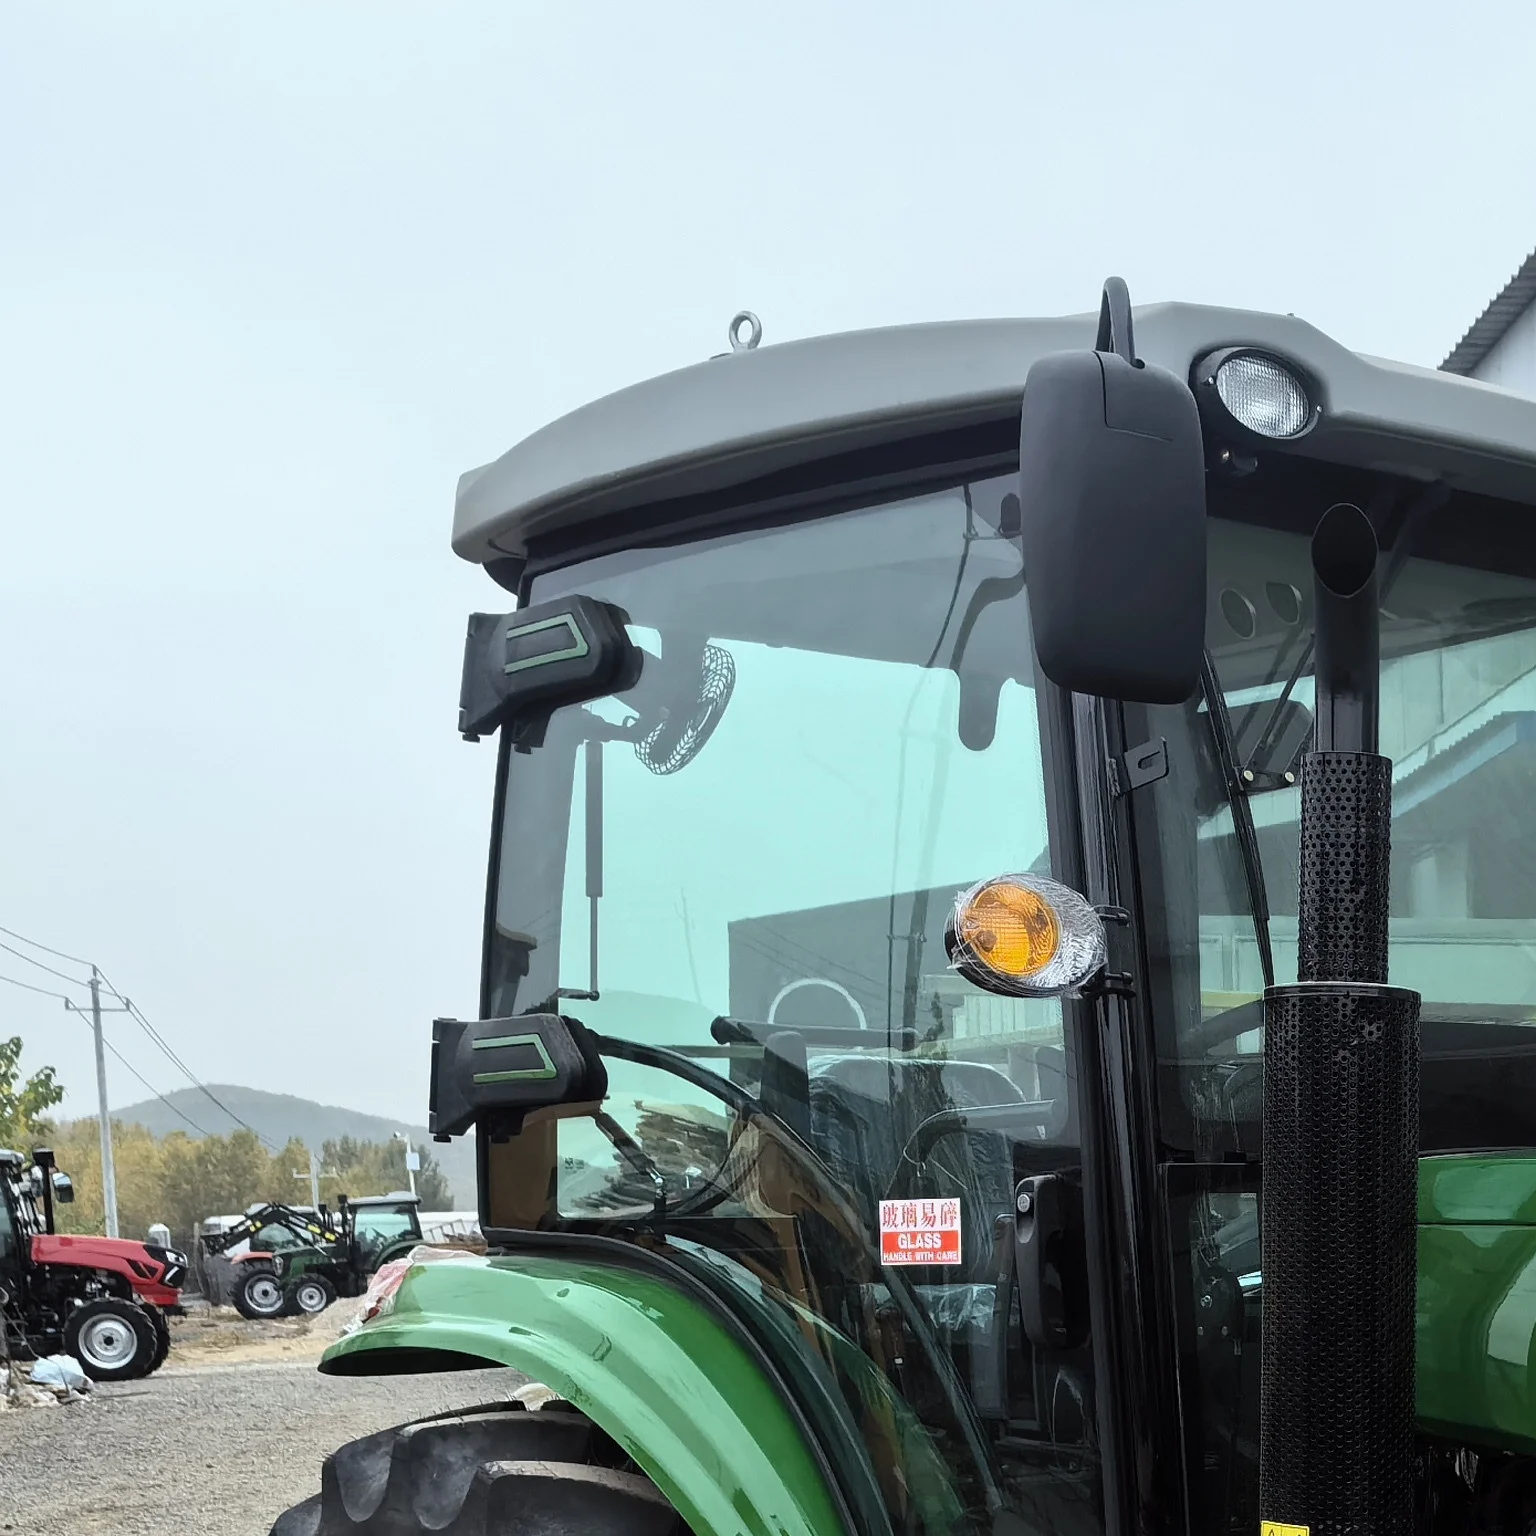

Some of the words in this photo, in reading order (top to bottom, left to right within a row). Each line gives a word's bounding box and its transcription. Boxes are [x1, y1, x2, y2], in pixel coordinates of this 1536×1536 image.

[897, 1232, 943, 1250] GLASS
[883, 1251, 912, 1262] HANDLE
[914, 1251, 934, 1262] WITH
[936, 1250, 957, 1262] CARE
